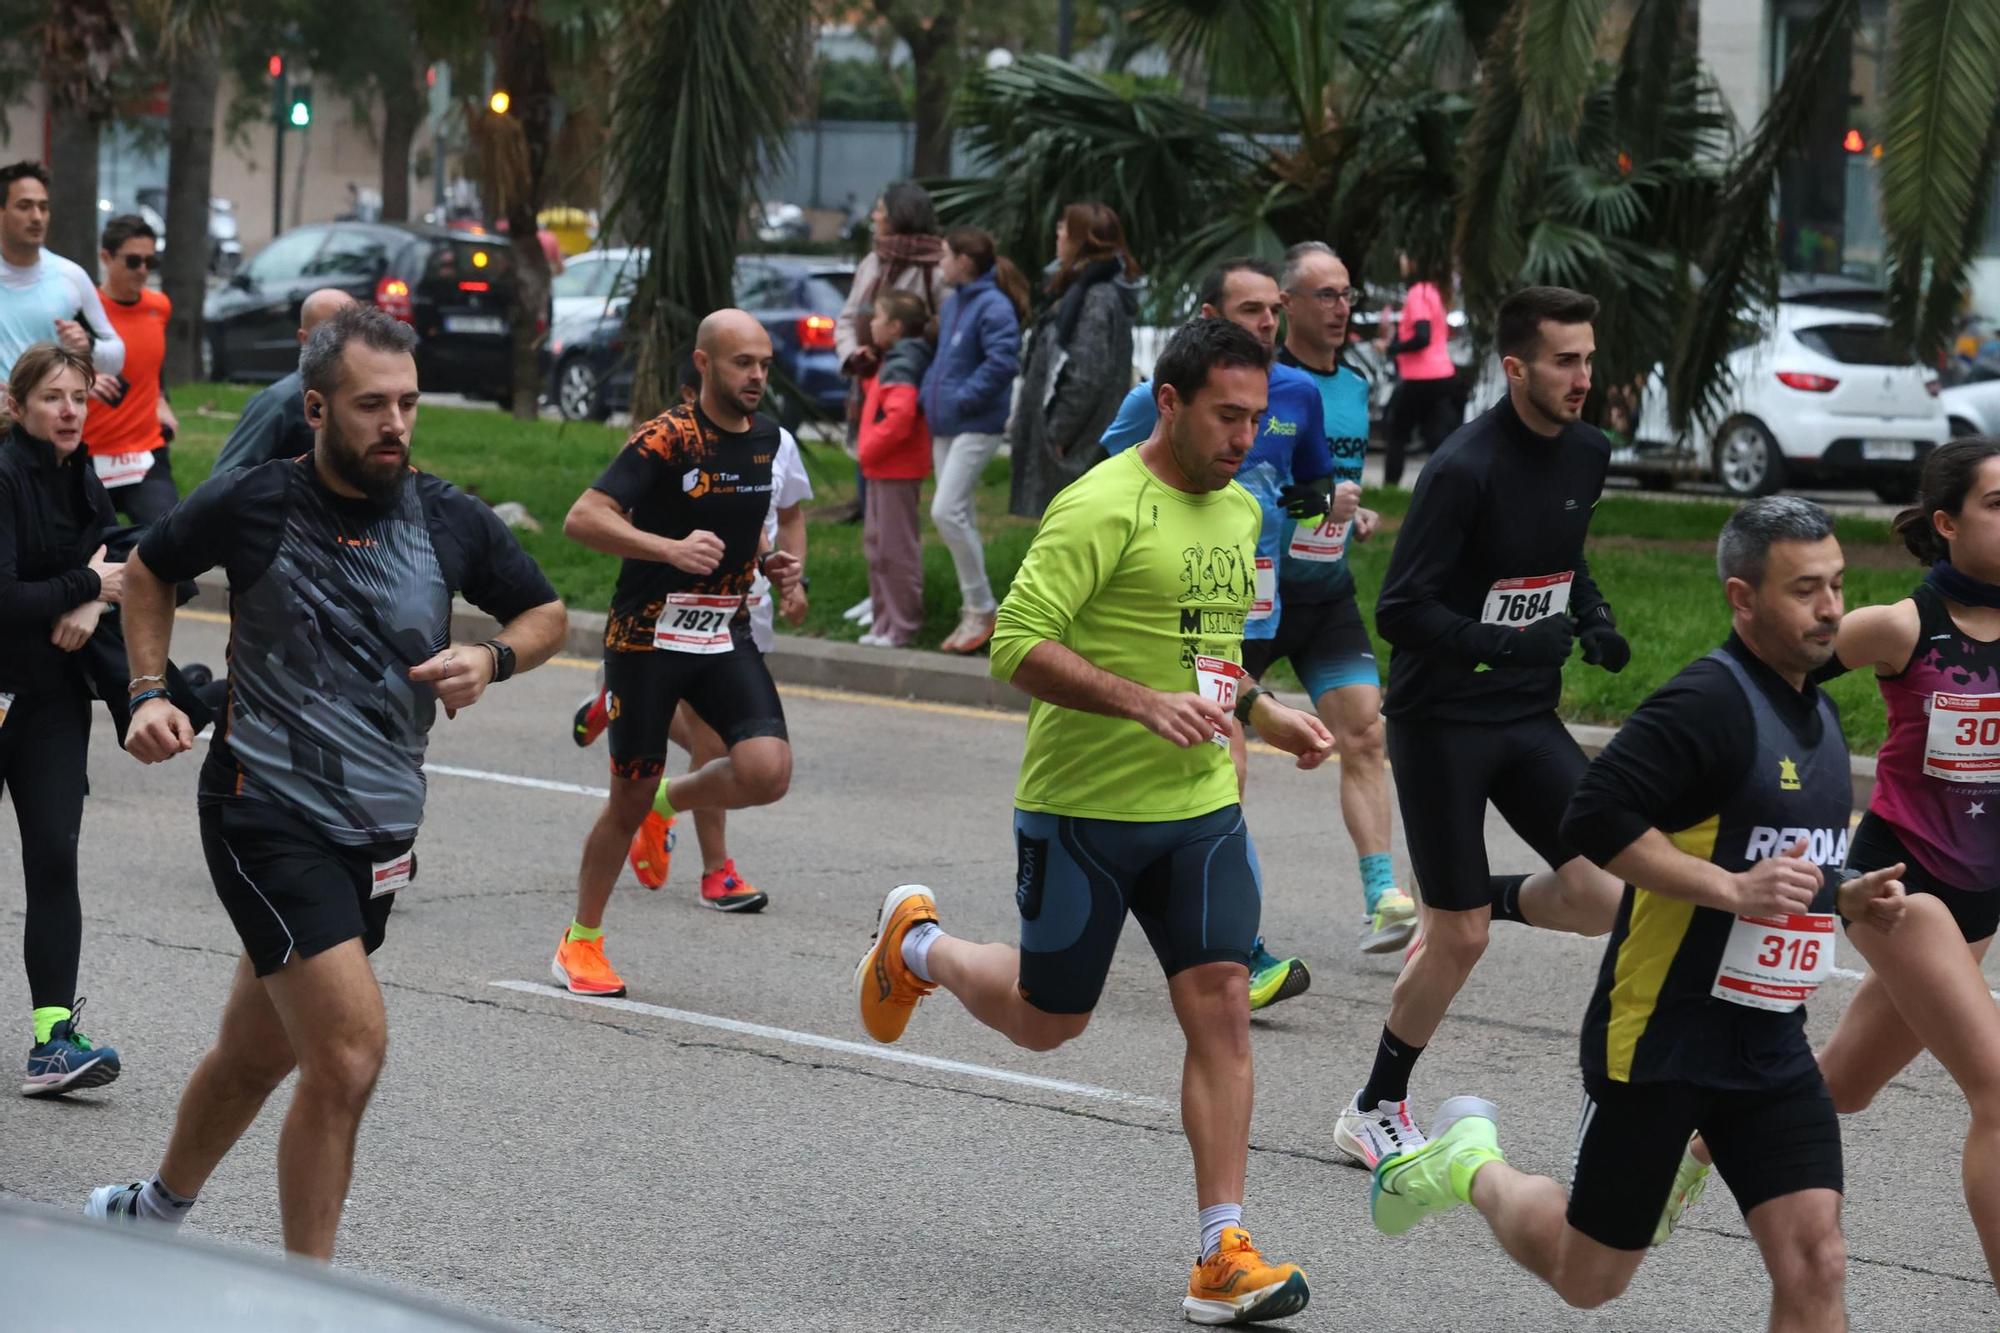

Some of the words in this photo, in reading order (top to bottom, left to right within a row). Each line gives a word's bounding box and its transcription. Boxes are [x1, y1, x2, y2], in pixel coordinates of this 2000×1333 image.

[672, 608, 725, 634] 7927
[1496, 590, 1552, 622] 7684
[1955, 718, 2000, 746] 30
[1758, 935, 1821, 972] 316
